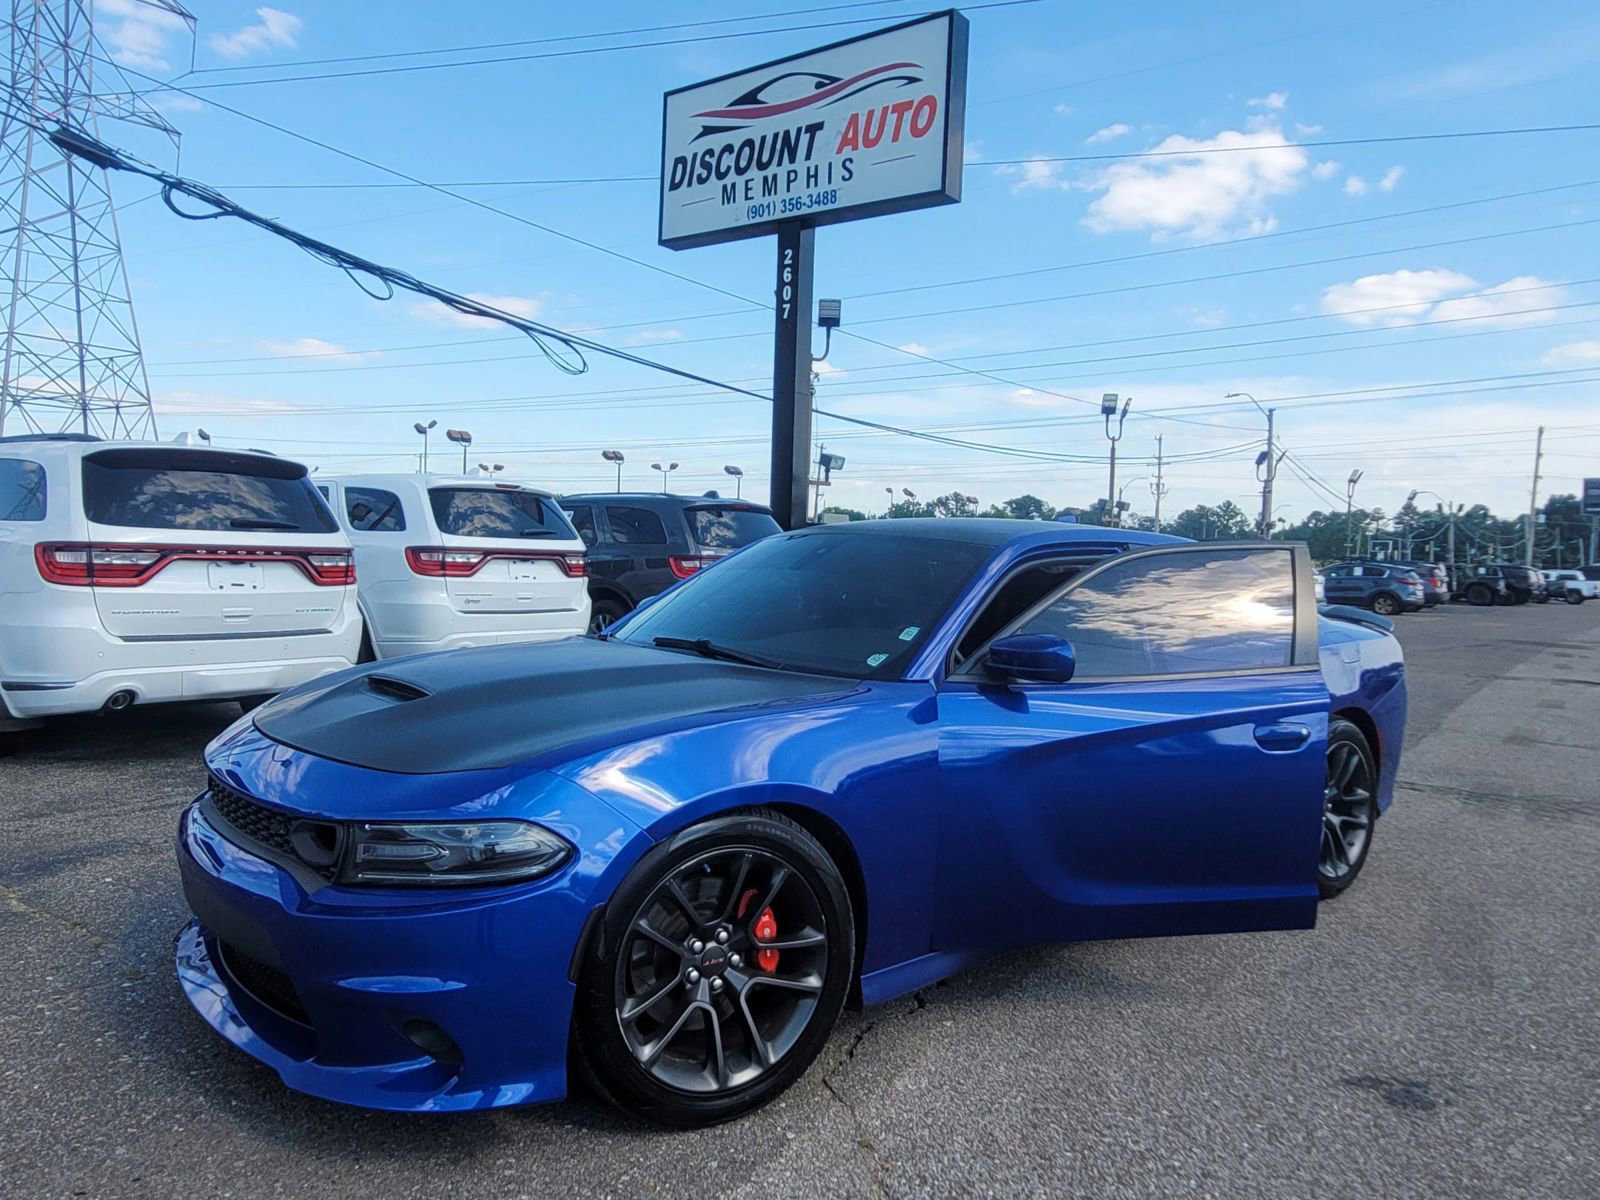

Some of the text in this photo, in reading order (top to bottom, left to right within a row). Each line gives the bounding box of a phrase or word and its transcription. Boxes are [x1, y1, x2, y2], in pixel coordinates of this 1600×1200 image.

[668, 95, 938, 192] DISCOUNT AUTO
[721, 157, 854, 206] MEMPHIS
[746, 189, 837, 220] (901) 356-3488
[781, 249, 793, 320] 2607
